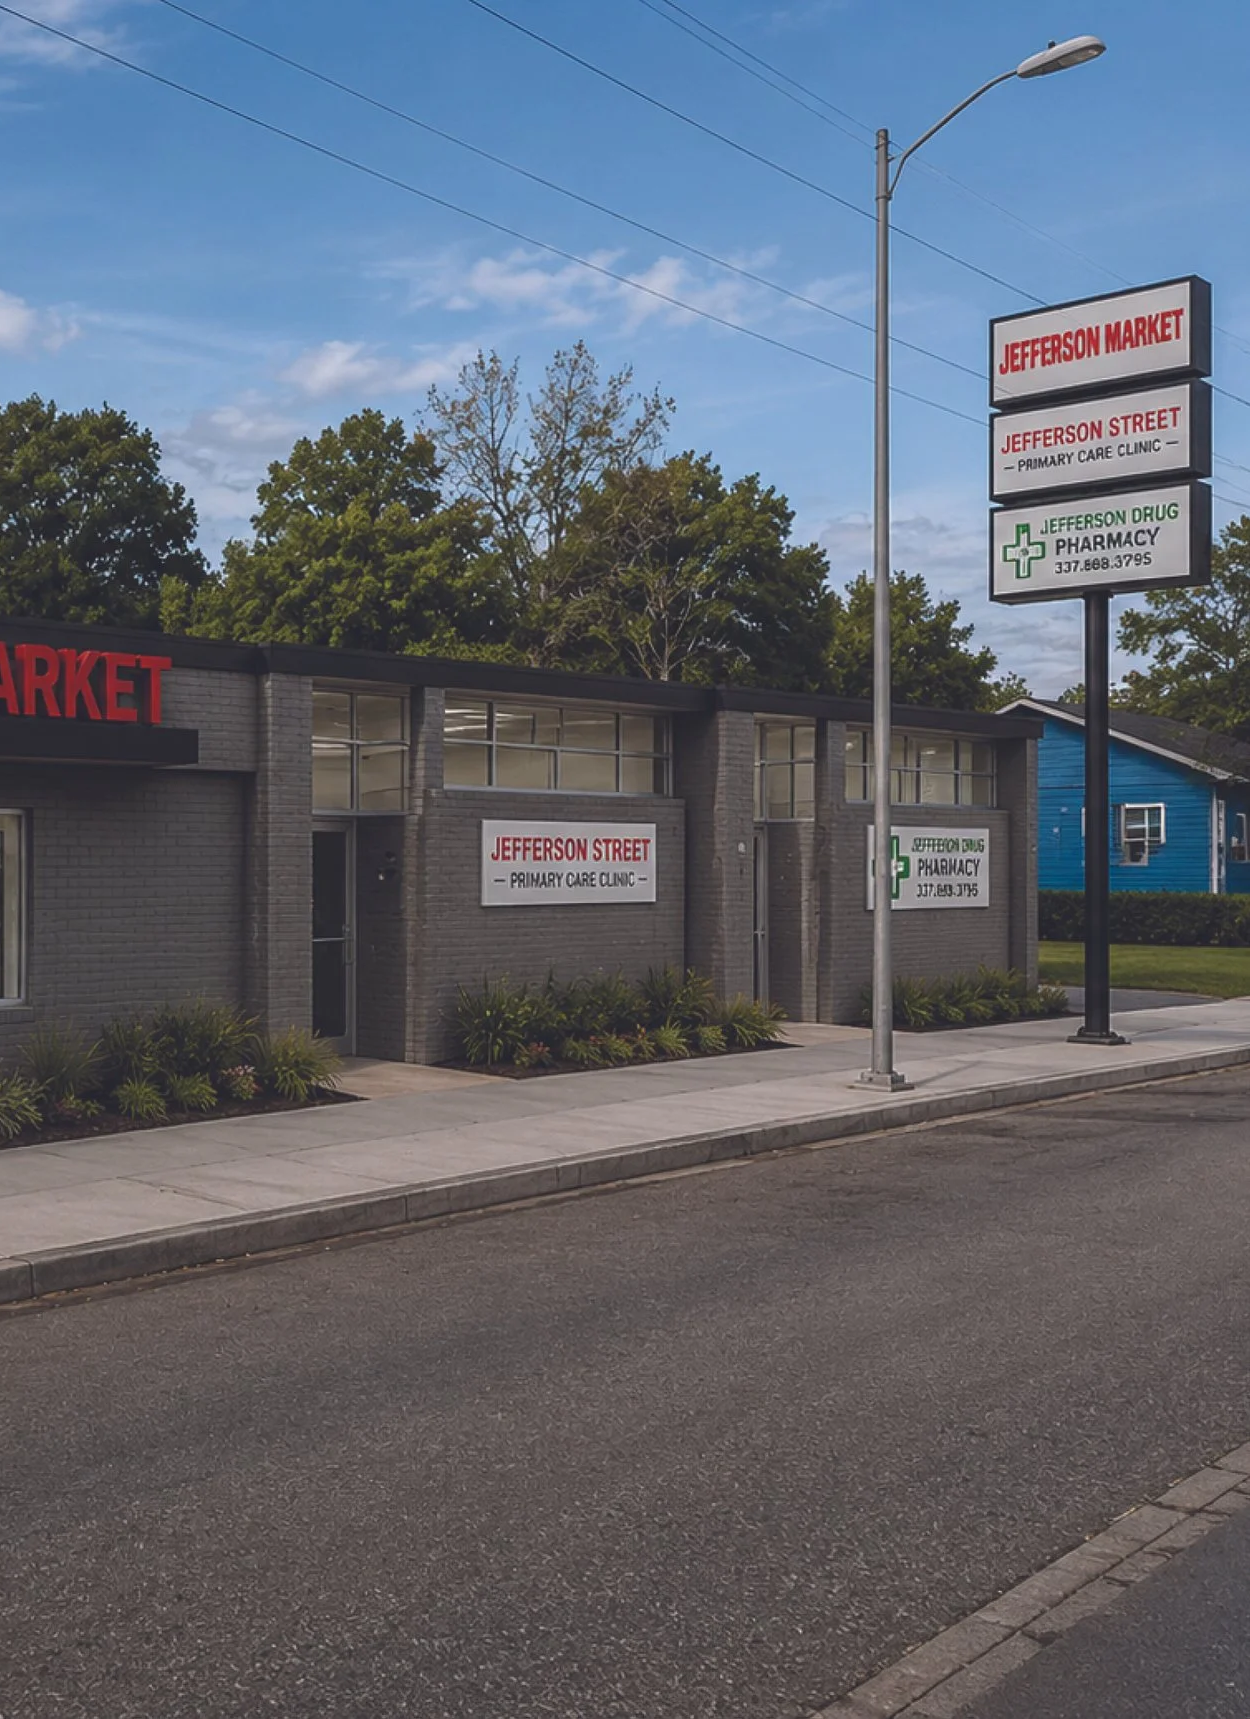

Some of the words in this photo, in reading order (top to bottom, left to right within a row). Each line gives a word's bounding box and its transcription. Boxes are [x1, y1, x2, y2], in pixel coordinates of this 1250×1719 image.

[999, 326, 1100, 375] JEFFERSON
[1105, 308, 1184, 353] MARKET
[1001, 420, 1103, 454] JEFFERSON
[1108, 406, 1181, 437] STREET
[1018, 452, 1074, 472] PRIMARY
[1077, 445, 1113, 463] CARE
[1117, 438, 1161, 457] CLINIC
[1040, 509, 1127, 535] JEFFERSON
[1131, 502, 1179, 524] DRUG
[1055, 526, 1161, 556] PHARMACY
[491, 836, 588, 862] JEFFERSON
[592, 838, 651, 862] STREET
[510, 872, 563, 889] PRIMARY
[565, 872, 597, 888] CARE
[599, 871, 635, 888] CLINIC
